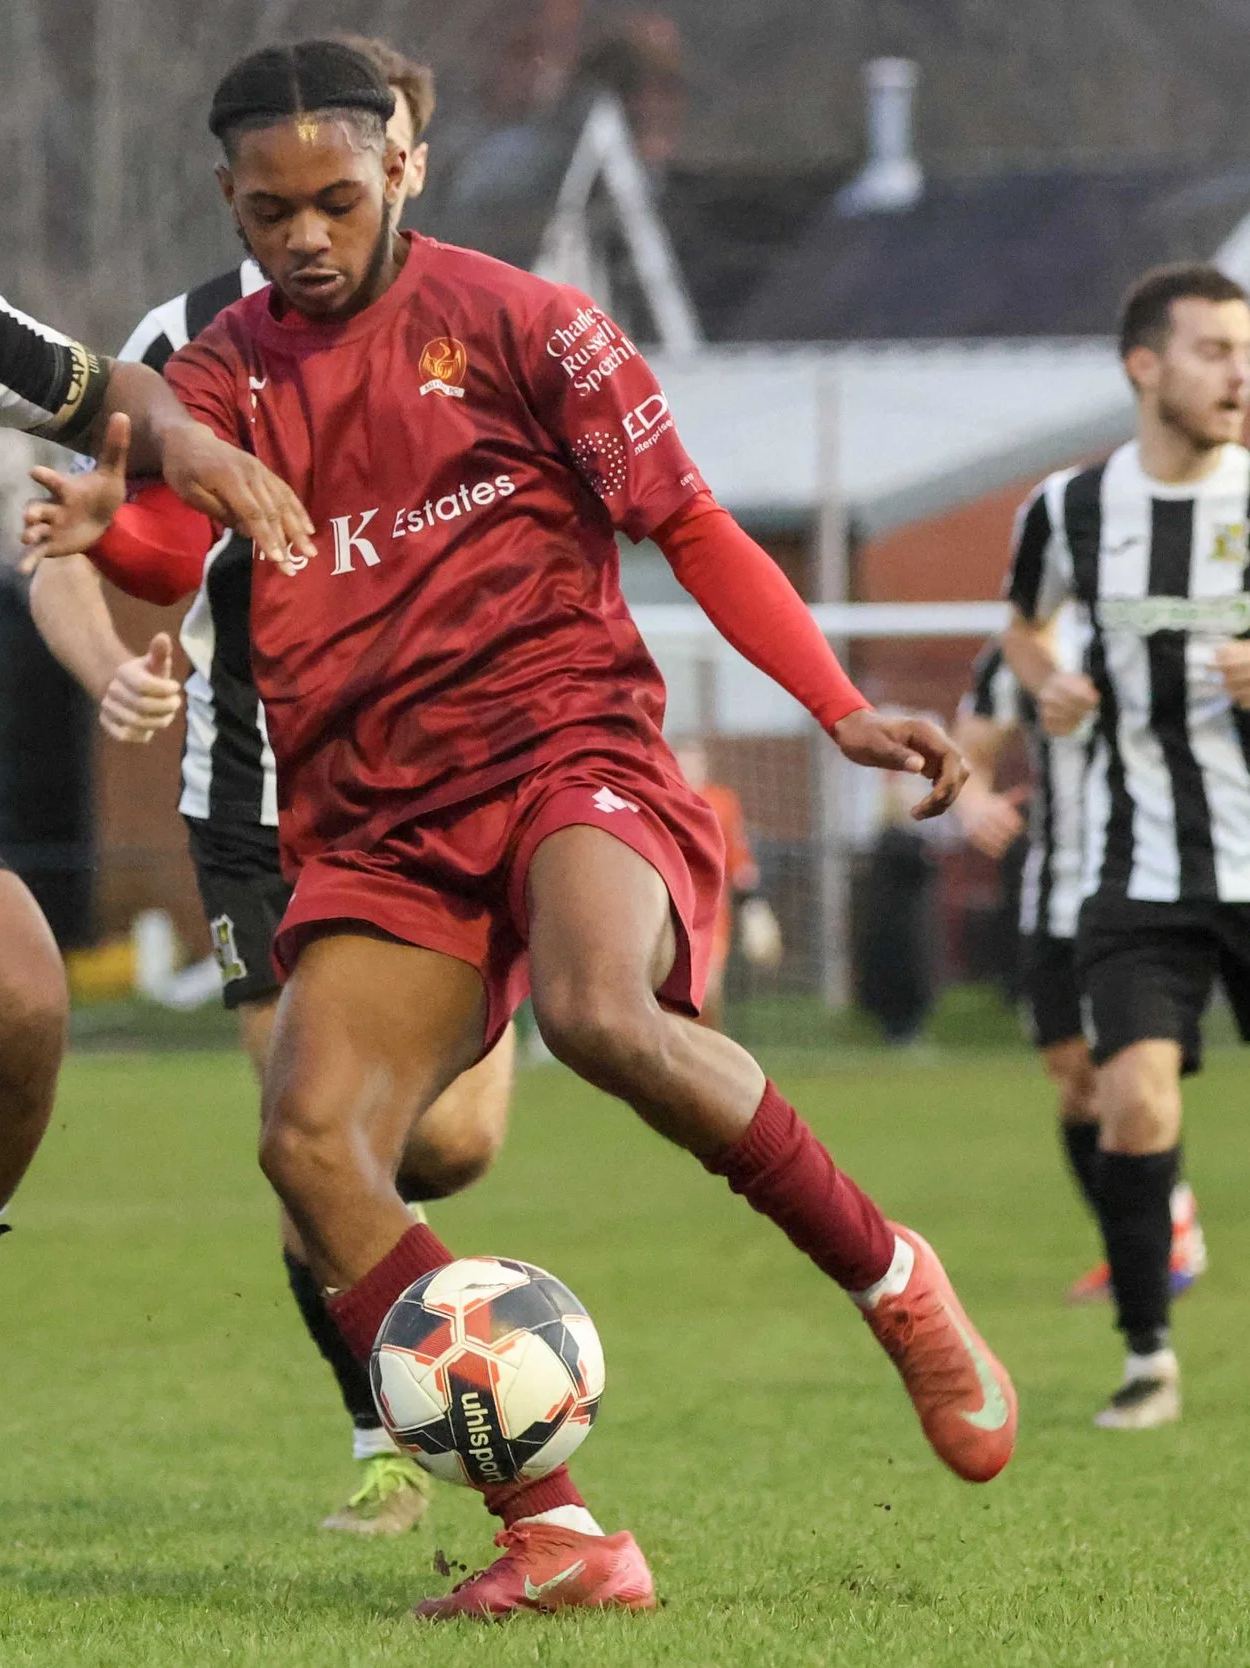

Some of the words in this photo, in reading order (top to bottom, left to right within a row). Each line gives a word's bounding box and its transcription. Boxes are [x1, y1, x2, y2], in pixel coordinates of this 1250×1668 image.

[561, 319, 616, 379] Russell
[329, 508, 382, 575] K
[392, 474, 516, 539] Estates
